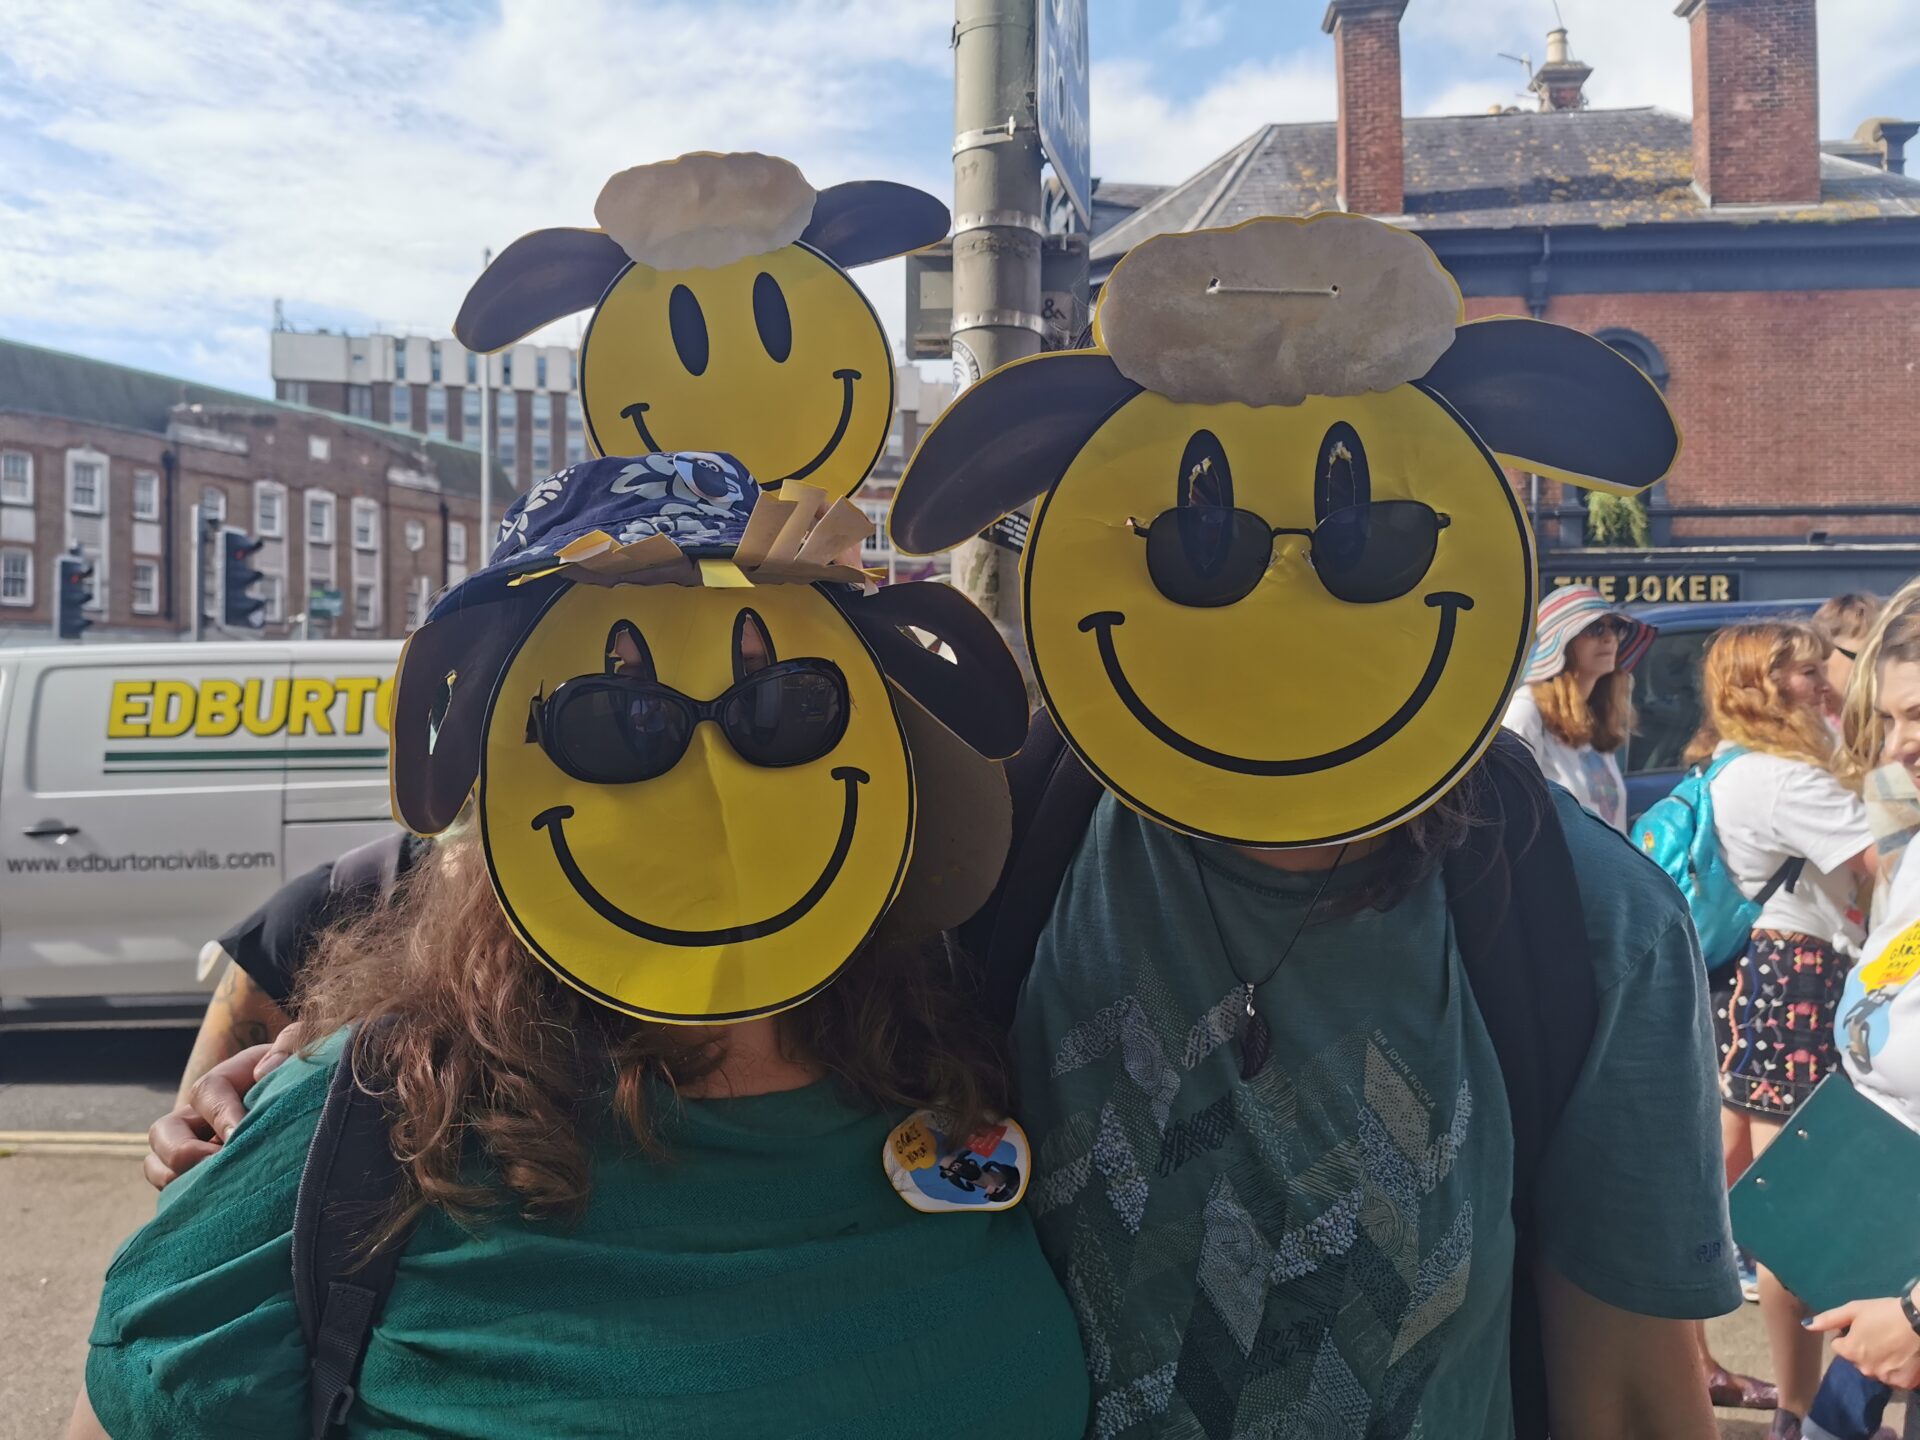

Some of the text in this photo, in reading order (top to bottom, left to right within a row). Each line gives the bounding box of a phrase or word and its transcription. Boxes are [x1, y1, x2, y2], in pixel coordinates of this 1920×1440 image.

[1625, 575, 1730, 602] JOKER
[7, 851, 275, 874] www.edburtoncivils.com
[1373, 1028, 1437, 1109] RJR JOHN ROCHA
